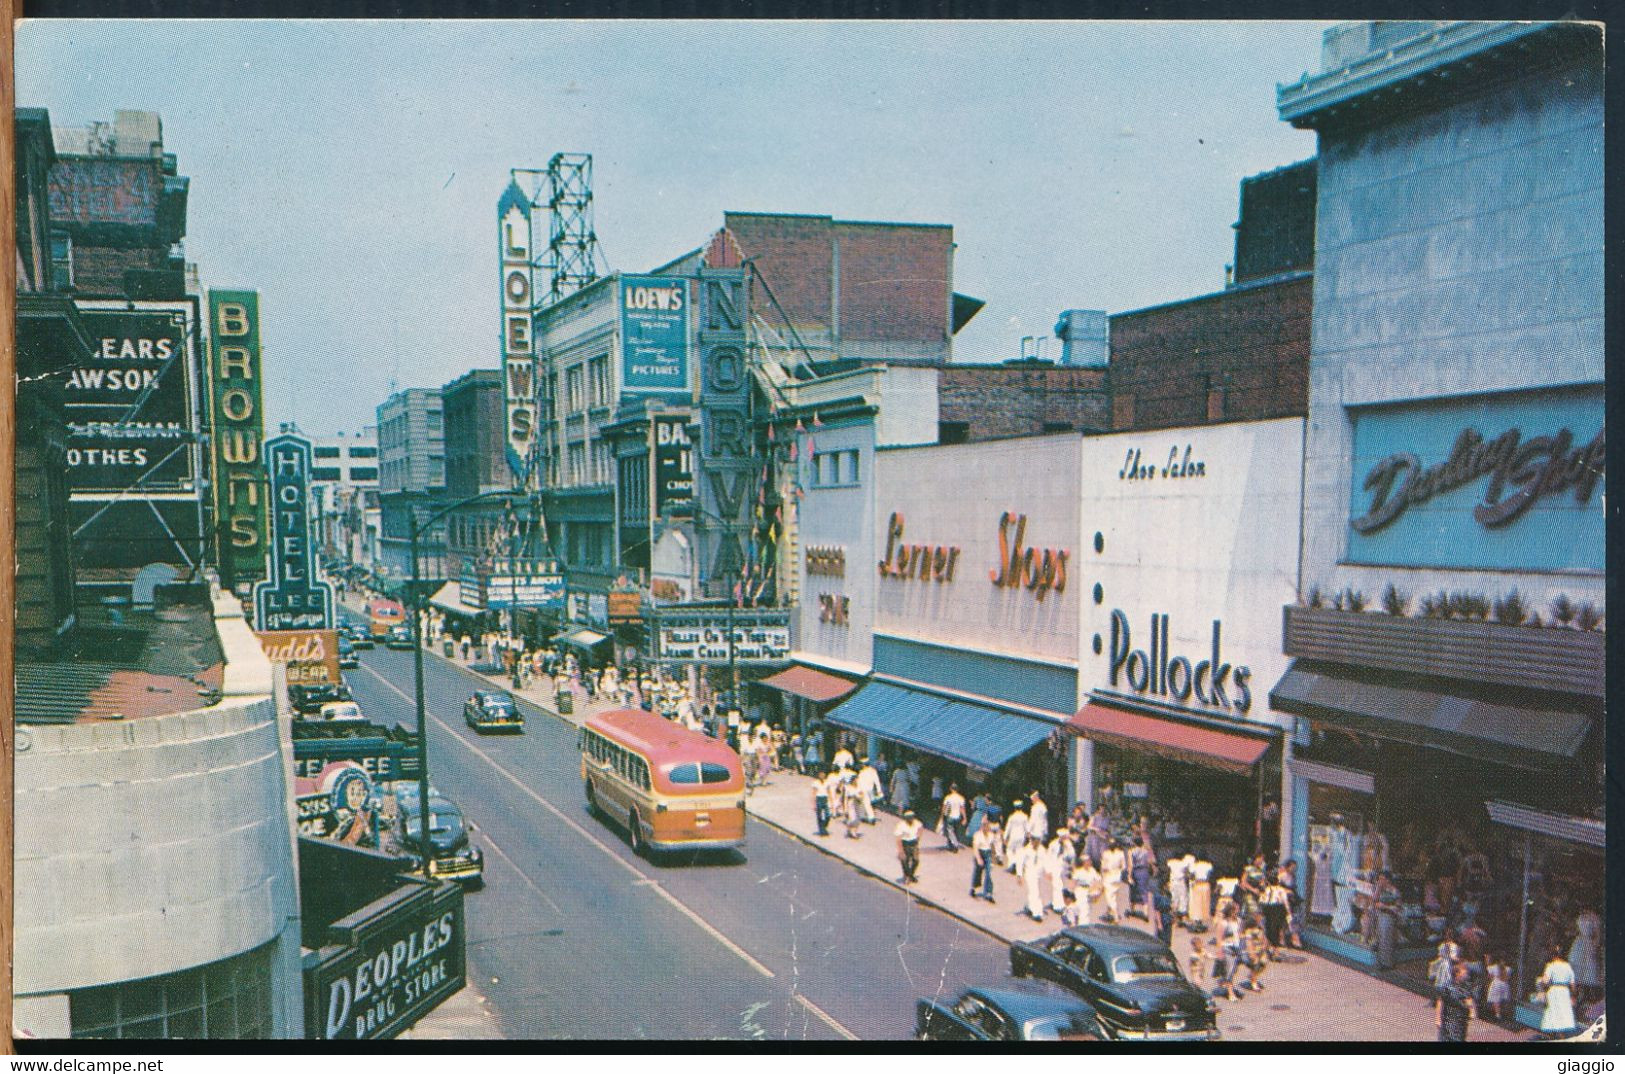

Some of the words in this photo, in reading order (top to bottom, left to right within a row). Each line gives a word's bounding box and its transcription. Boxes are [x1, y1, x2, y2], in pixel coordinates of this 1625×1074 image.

[625, 282, 682, 311] LOEW'S
[93, 337, 173, 360] EARS
[631, 365, 681, 376] PICTURES
[657, 422, 692, 446] BA
[706, 279, 750, 580] NORVA
[1118, 447, 1155, 481] Shoe
[1162, 443, 1206, 479] Salon
[667, 480, 692, 491] CHO
[277, 451, 304, 581] HOTEL
[878, 511, 961, 584] Lerner
[988, 511, 1071, 603] Shops
[269, 594, 322, 608] LEE
[258, 633, 325, 662] udd's
[1108, 607, 1252, 713] Pollocks
[355, 995, 395, 1040] DRUG
[405, 958, 447, 1004] STORE
